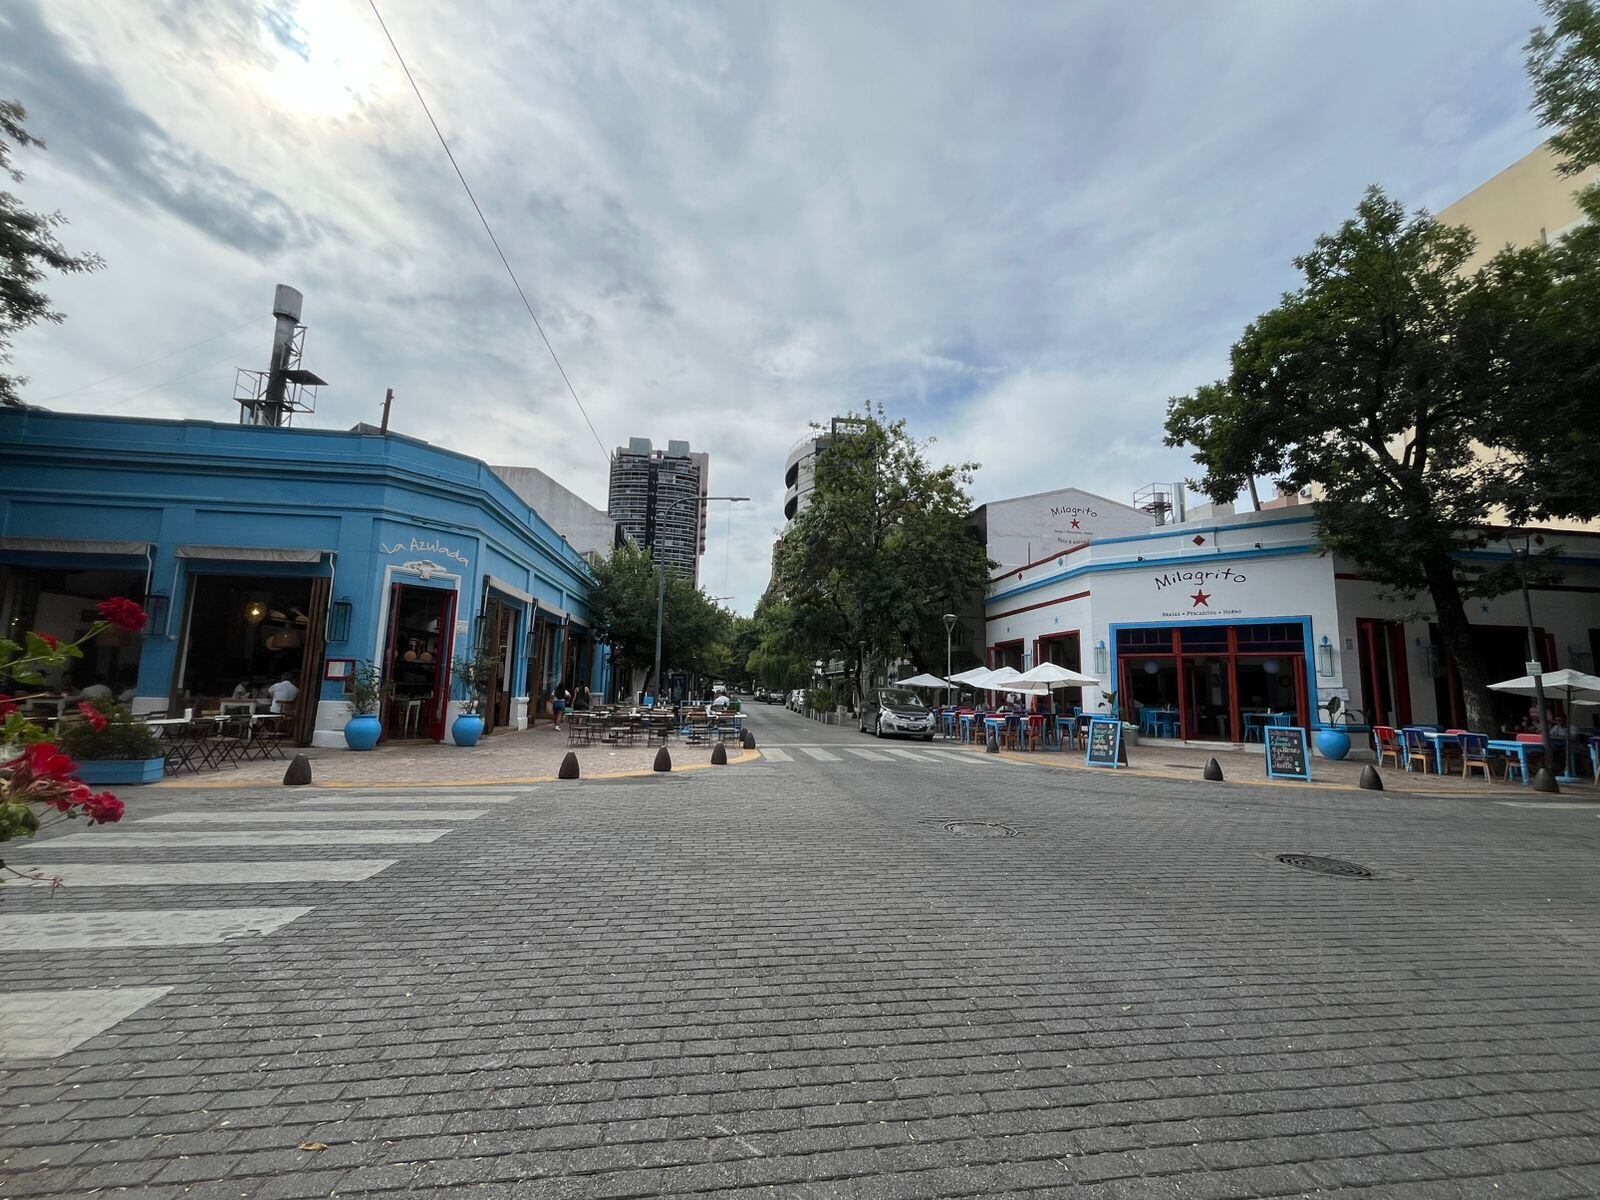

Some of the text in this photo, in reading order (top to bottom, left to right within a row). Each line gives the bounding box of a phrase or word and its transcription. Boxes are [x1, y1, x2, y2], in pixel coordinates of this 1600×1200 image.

[1051, 506, 1097, 517] Milagrito
[382, 538, 469, 567] La Azulada
[1155, 568, 1246, 590] Milagrito
